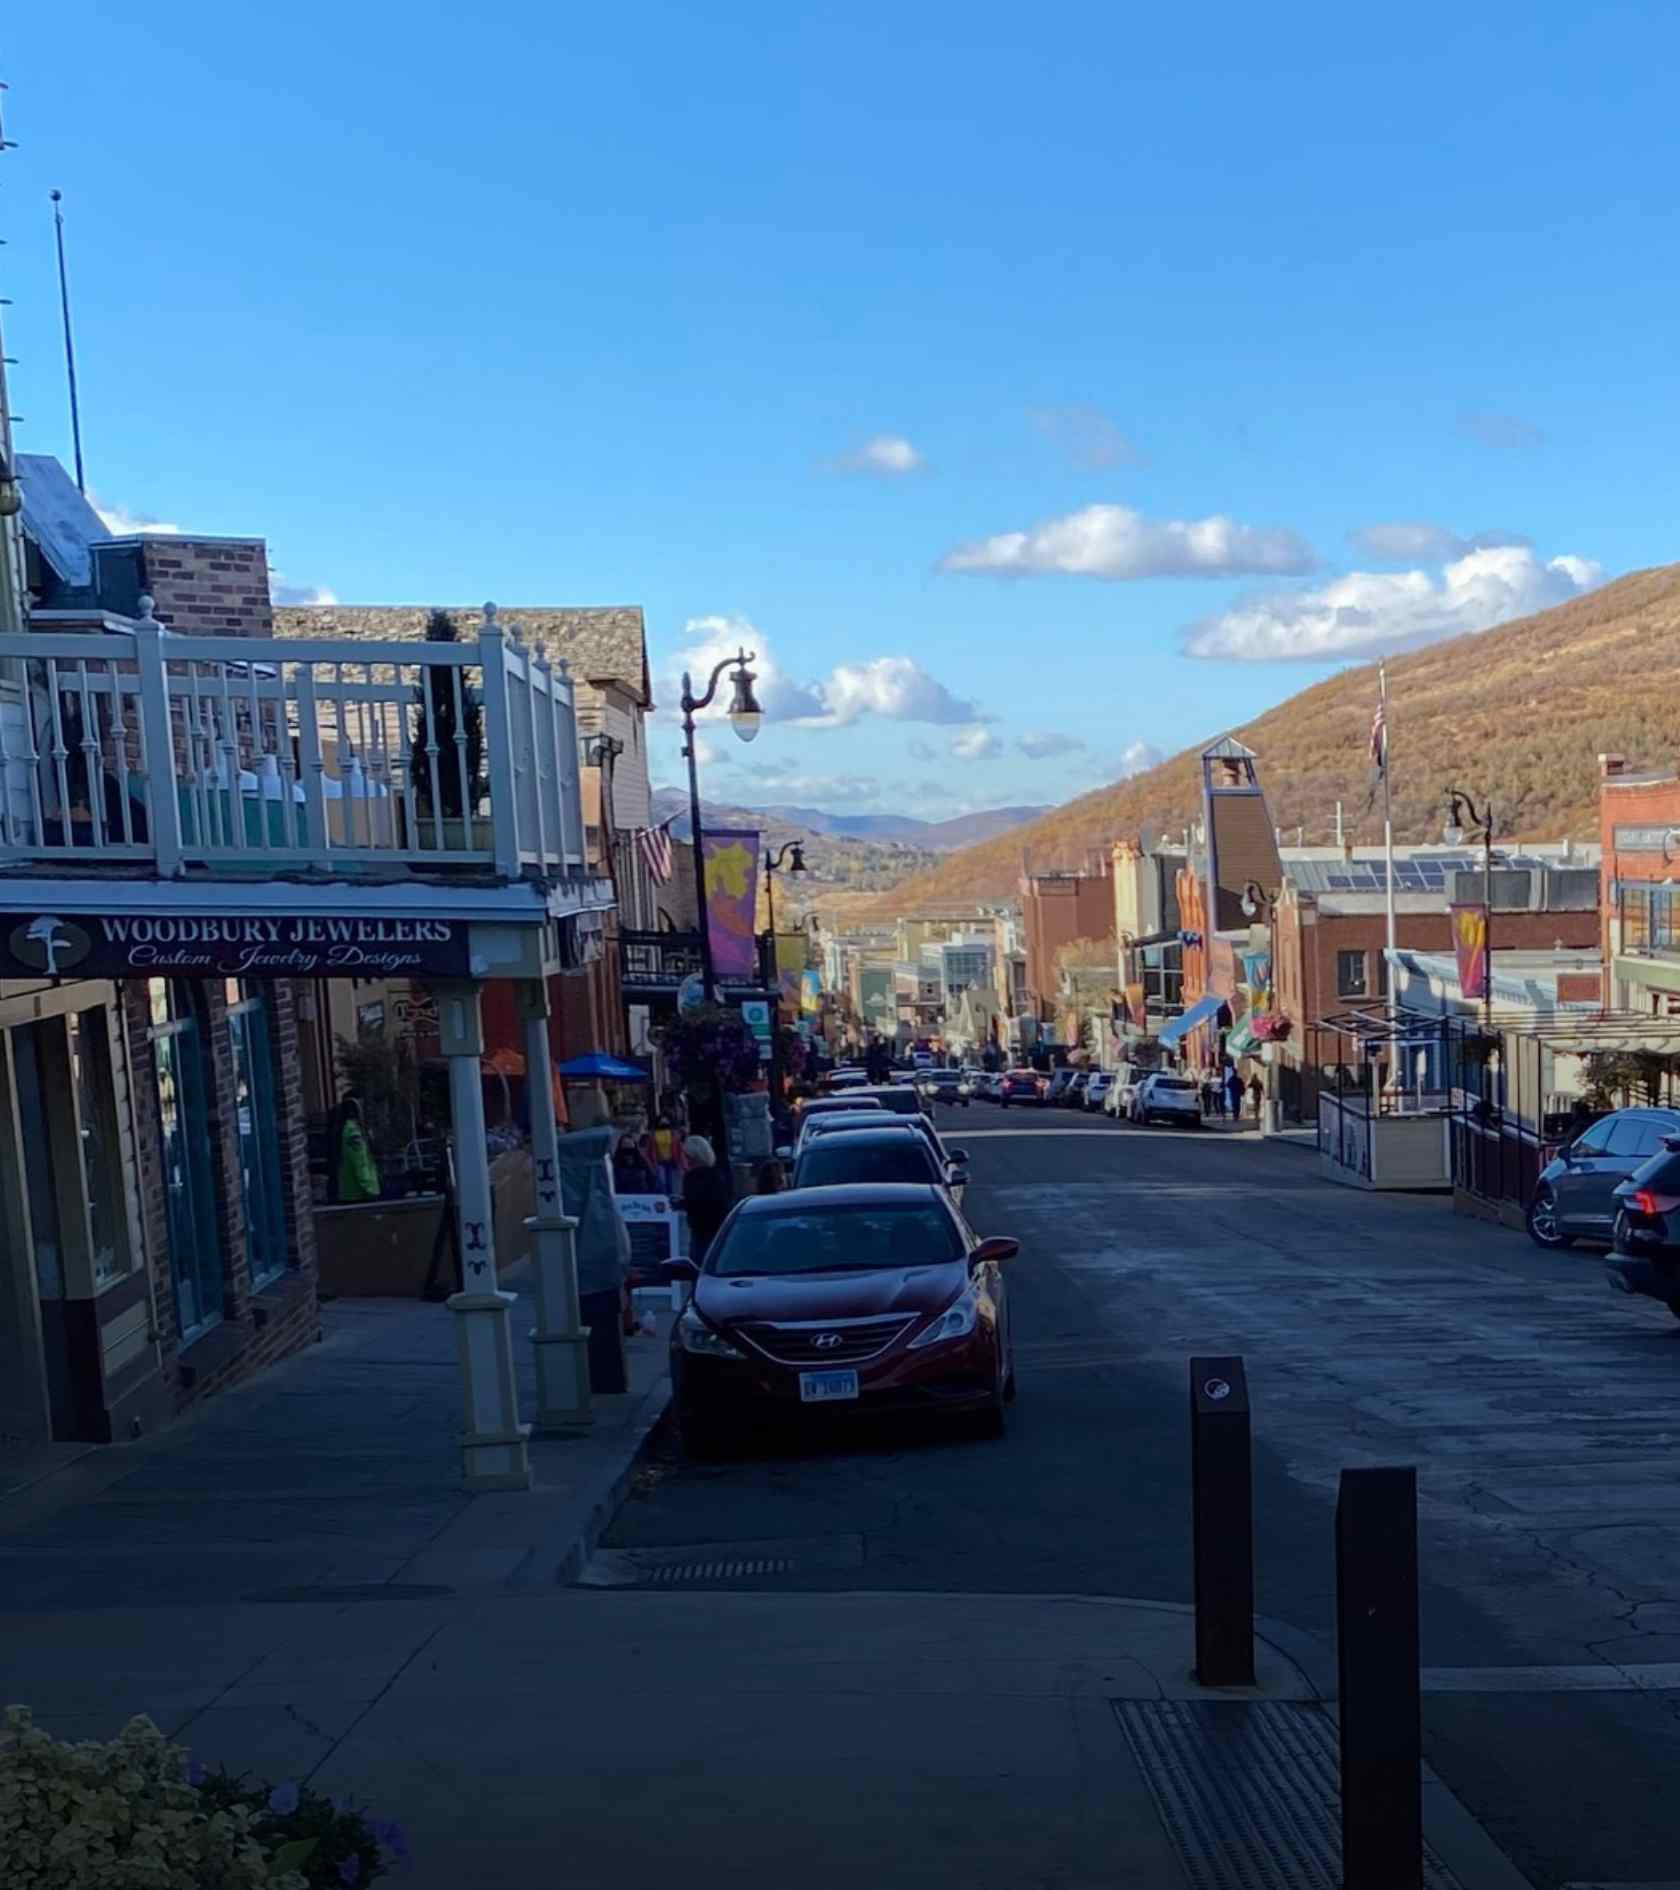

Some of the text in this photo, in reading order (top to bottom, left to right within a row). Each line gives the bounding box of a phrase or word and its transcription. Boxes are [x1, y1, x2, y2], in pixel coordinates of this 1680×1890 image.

[101, 919, 452, 943] WOODBURY JEWELERS
[127, 945, 422, 972] Custom Jewelry Designs
